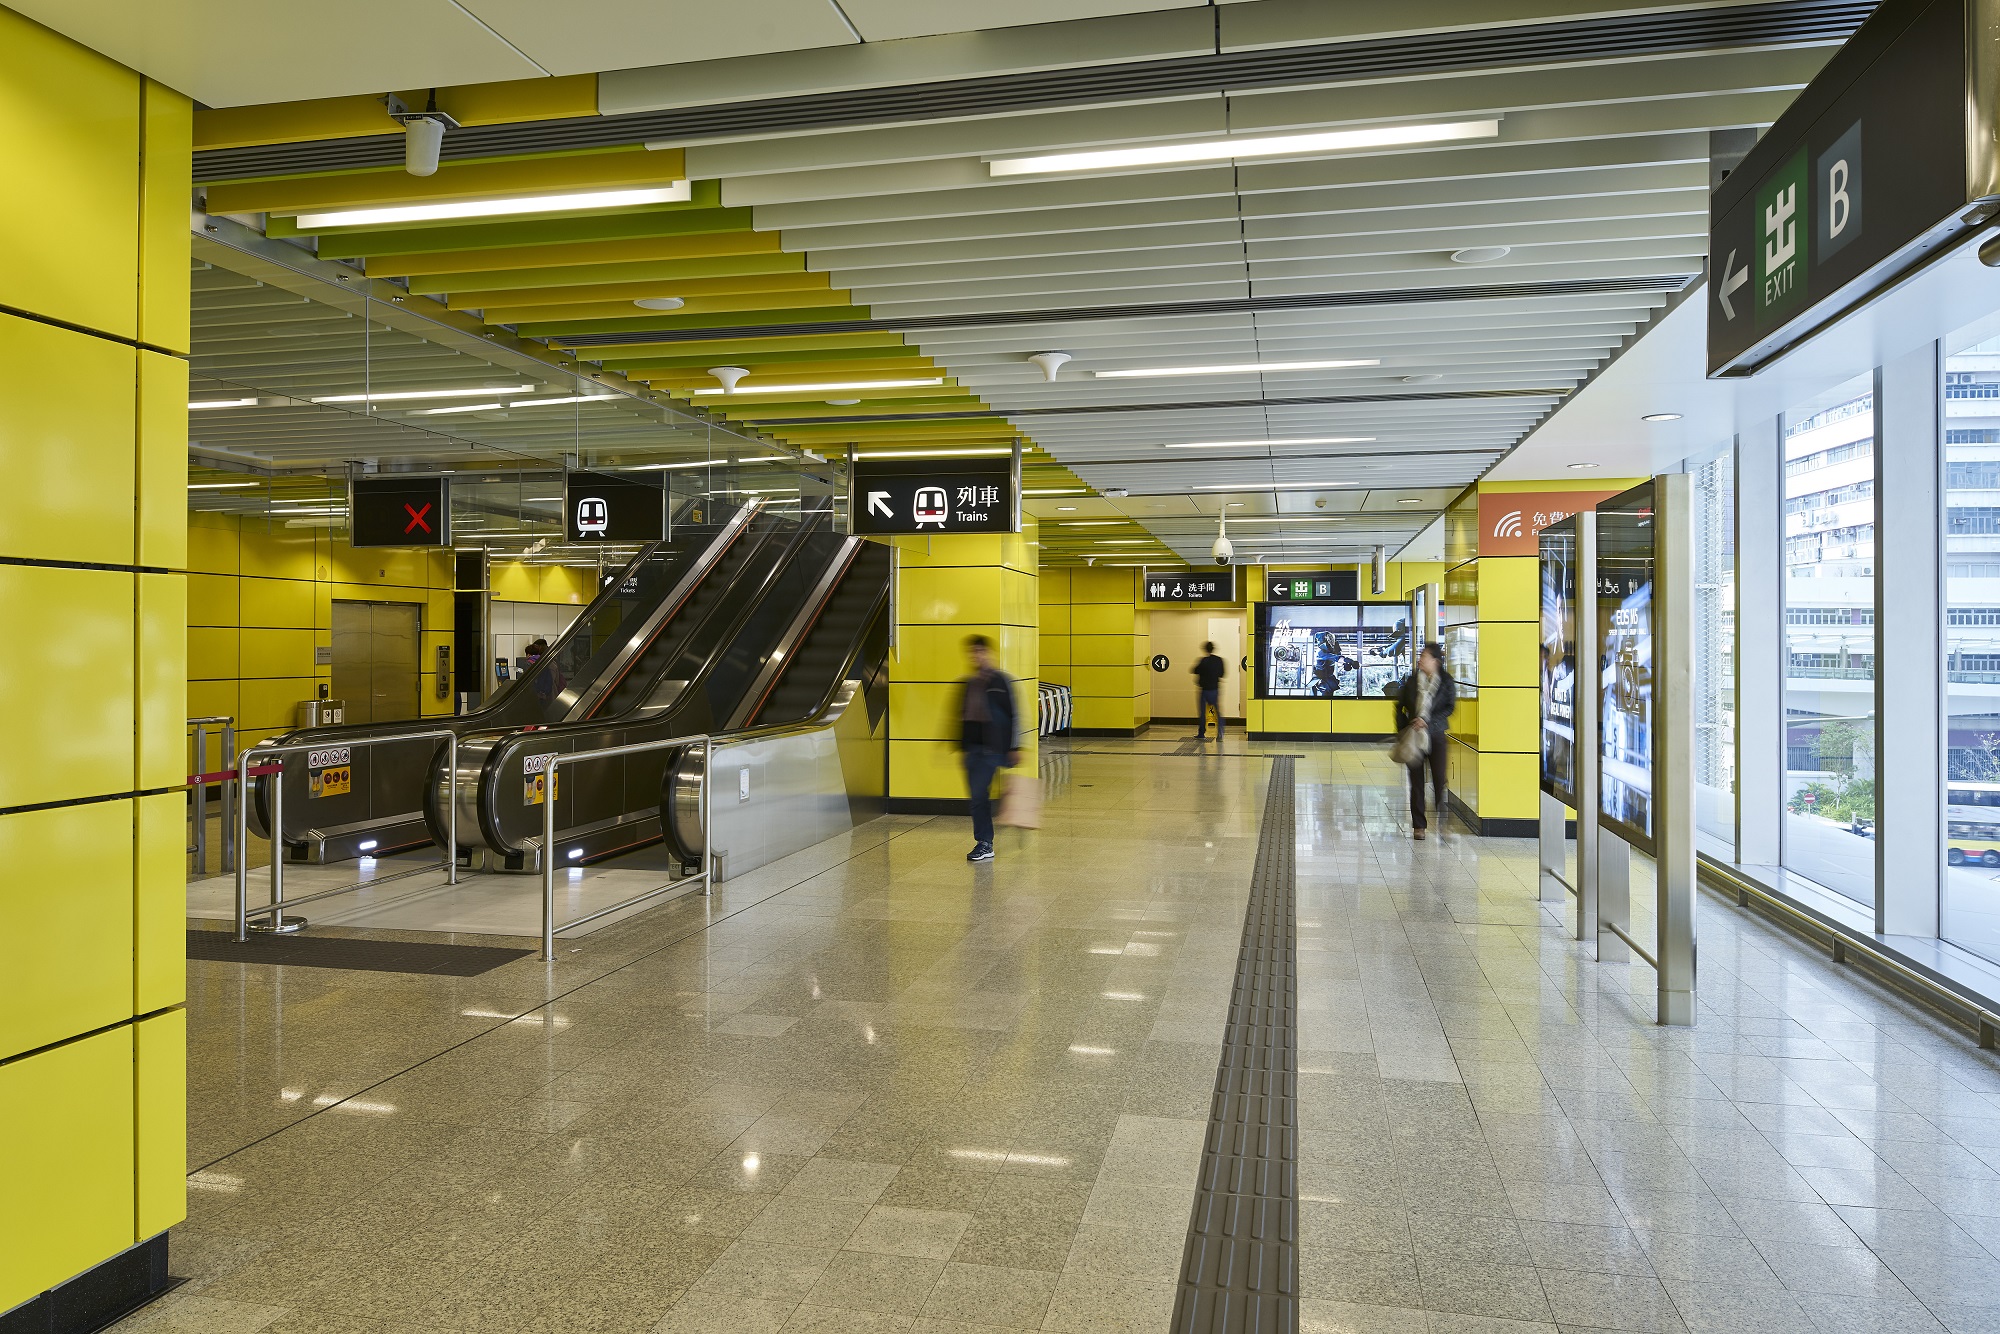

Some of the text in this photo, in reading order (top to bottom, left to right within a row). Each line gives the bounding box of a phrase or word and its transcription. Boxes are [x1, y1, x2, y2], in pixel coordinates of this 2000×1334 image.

[1829, 159, 1850, 240] B
[1765, 261, 1796, 307] EXIT
[956, 485, 1000, 508] 列車
[956, 511, 988, 522] Trains
[1188, 582, 1215, 592] 洗手間
[1319, 584, 1327, 595] B
[1616, 608, 1630, 625] EOS
[1275, 619, 1292, 629] 4K
